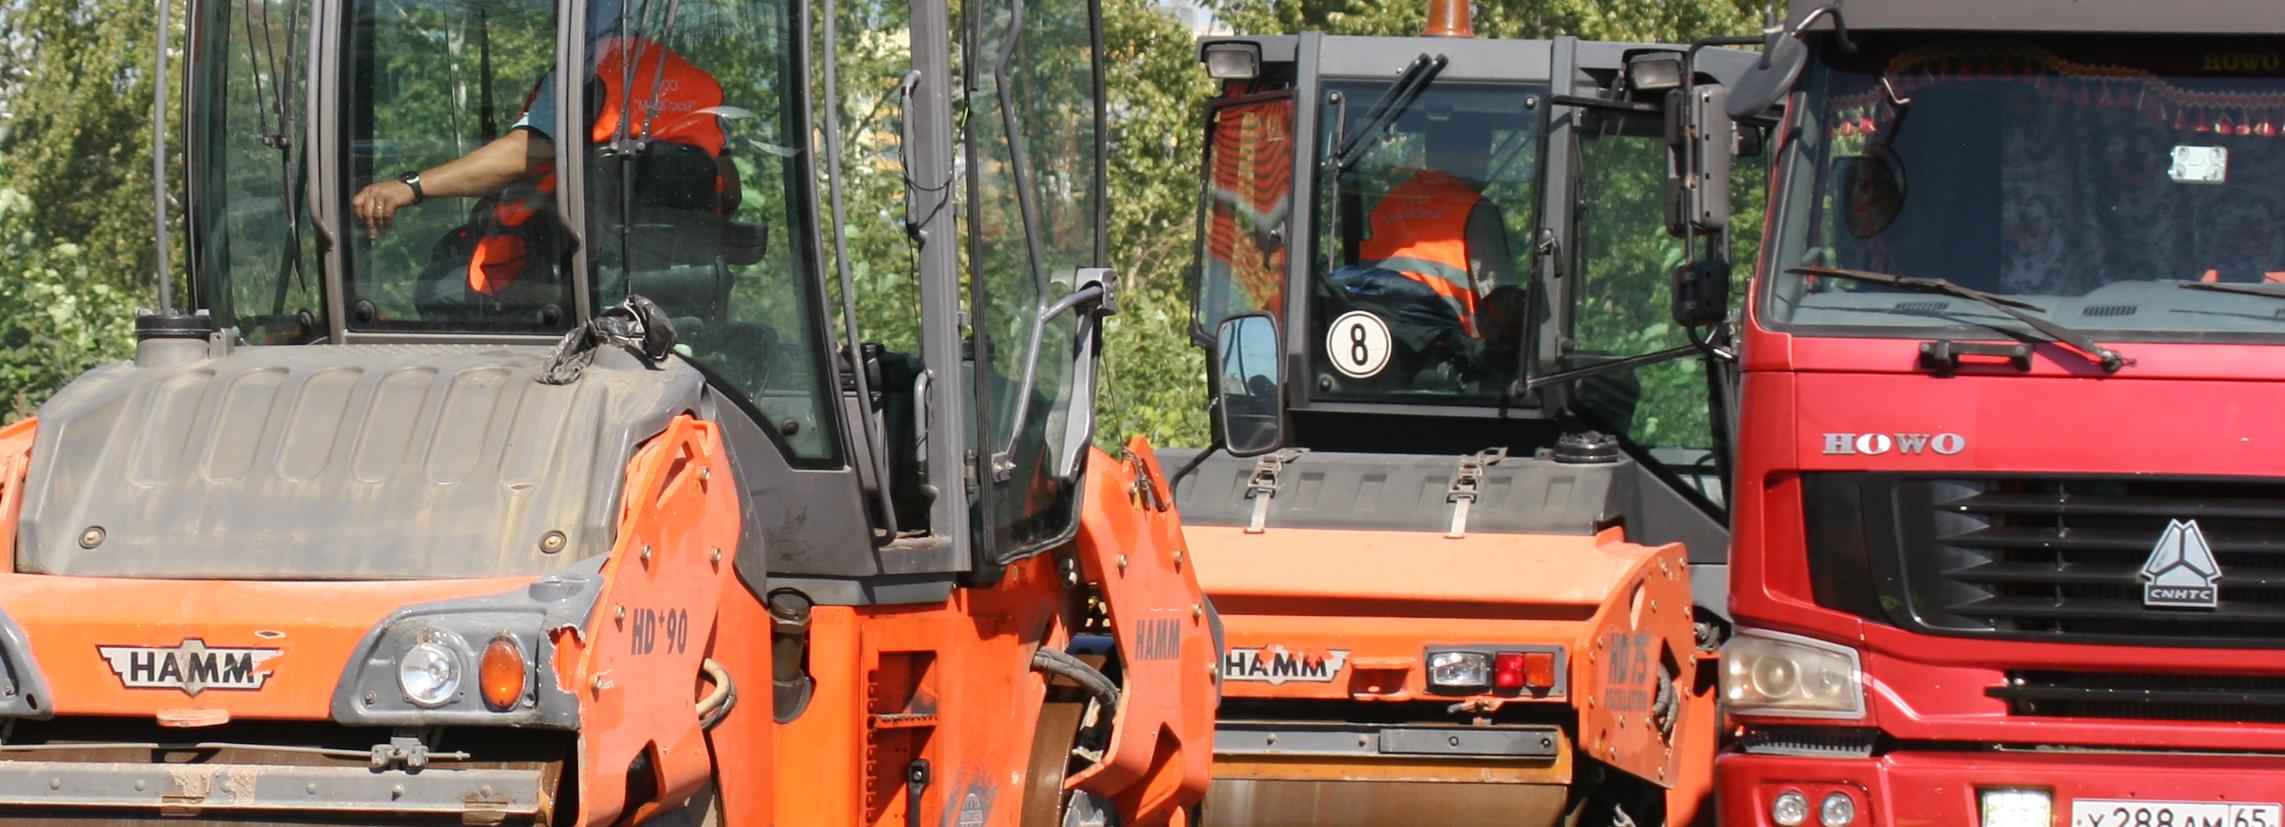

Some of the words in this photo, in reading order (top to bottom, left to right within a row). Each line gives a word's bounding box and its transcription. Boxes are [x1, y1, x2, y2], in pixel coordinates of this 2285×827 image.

[2202, 53, 2281, 71] HOWO
[1350, 322, 1369, 366] 8
[1821, 432, 1966, 455] HOWO
[2150, 588, 2212, 600] CNHTC
[1135, 618, 1181, 661] HAMM
[130, 651, 255, 684] HAMM
[1225, 651, 1328, 677] HAMM
[2235, 808, 2267, 827] 65
